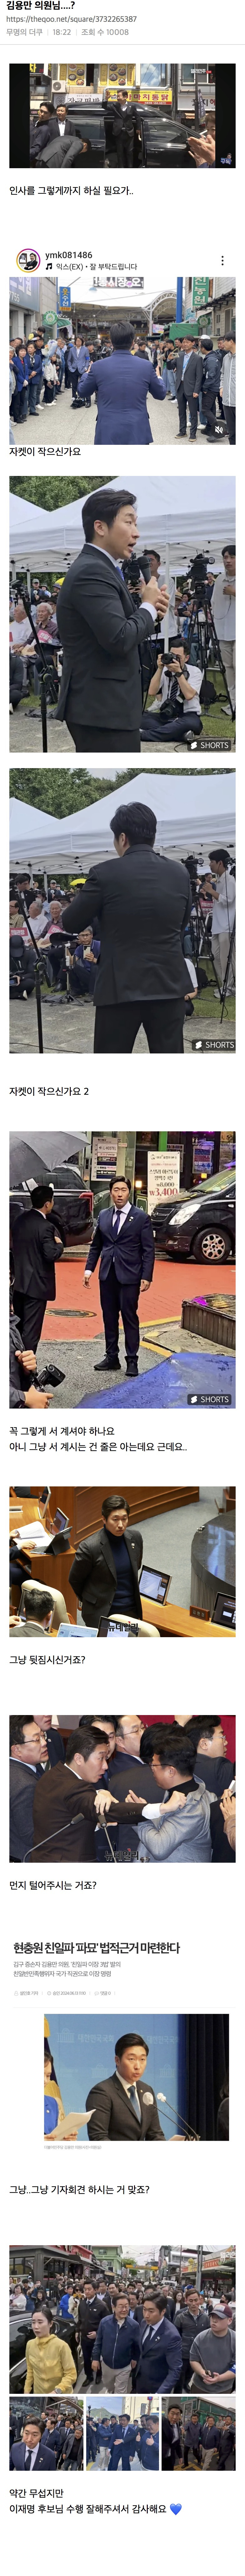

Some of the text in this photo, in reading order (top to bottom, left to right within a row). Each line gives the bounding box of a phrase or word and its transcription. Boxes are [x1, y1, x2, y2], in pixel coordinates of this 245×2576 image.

[14, 1942, 180, 1954] 현충원 친일파 '파묘' 법적근거 마련한다
[78, 2034, 114, 2043] 대한민국국회
